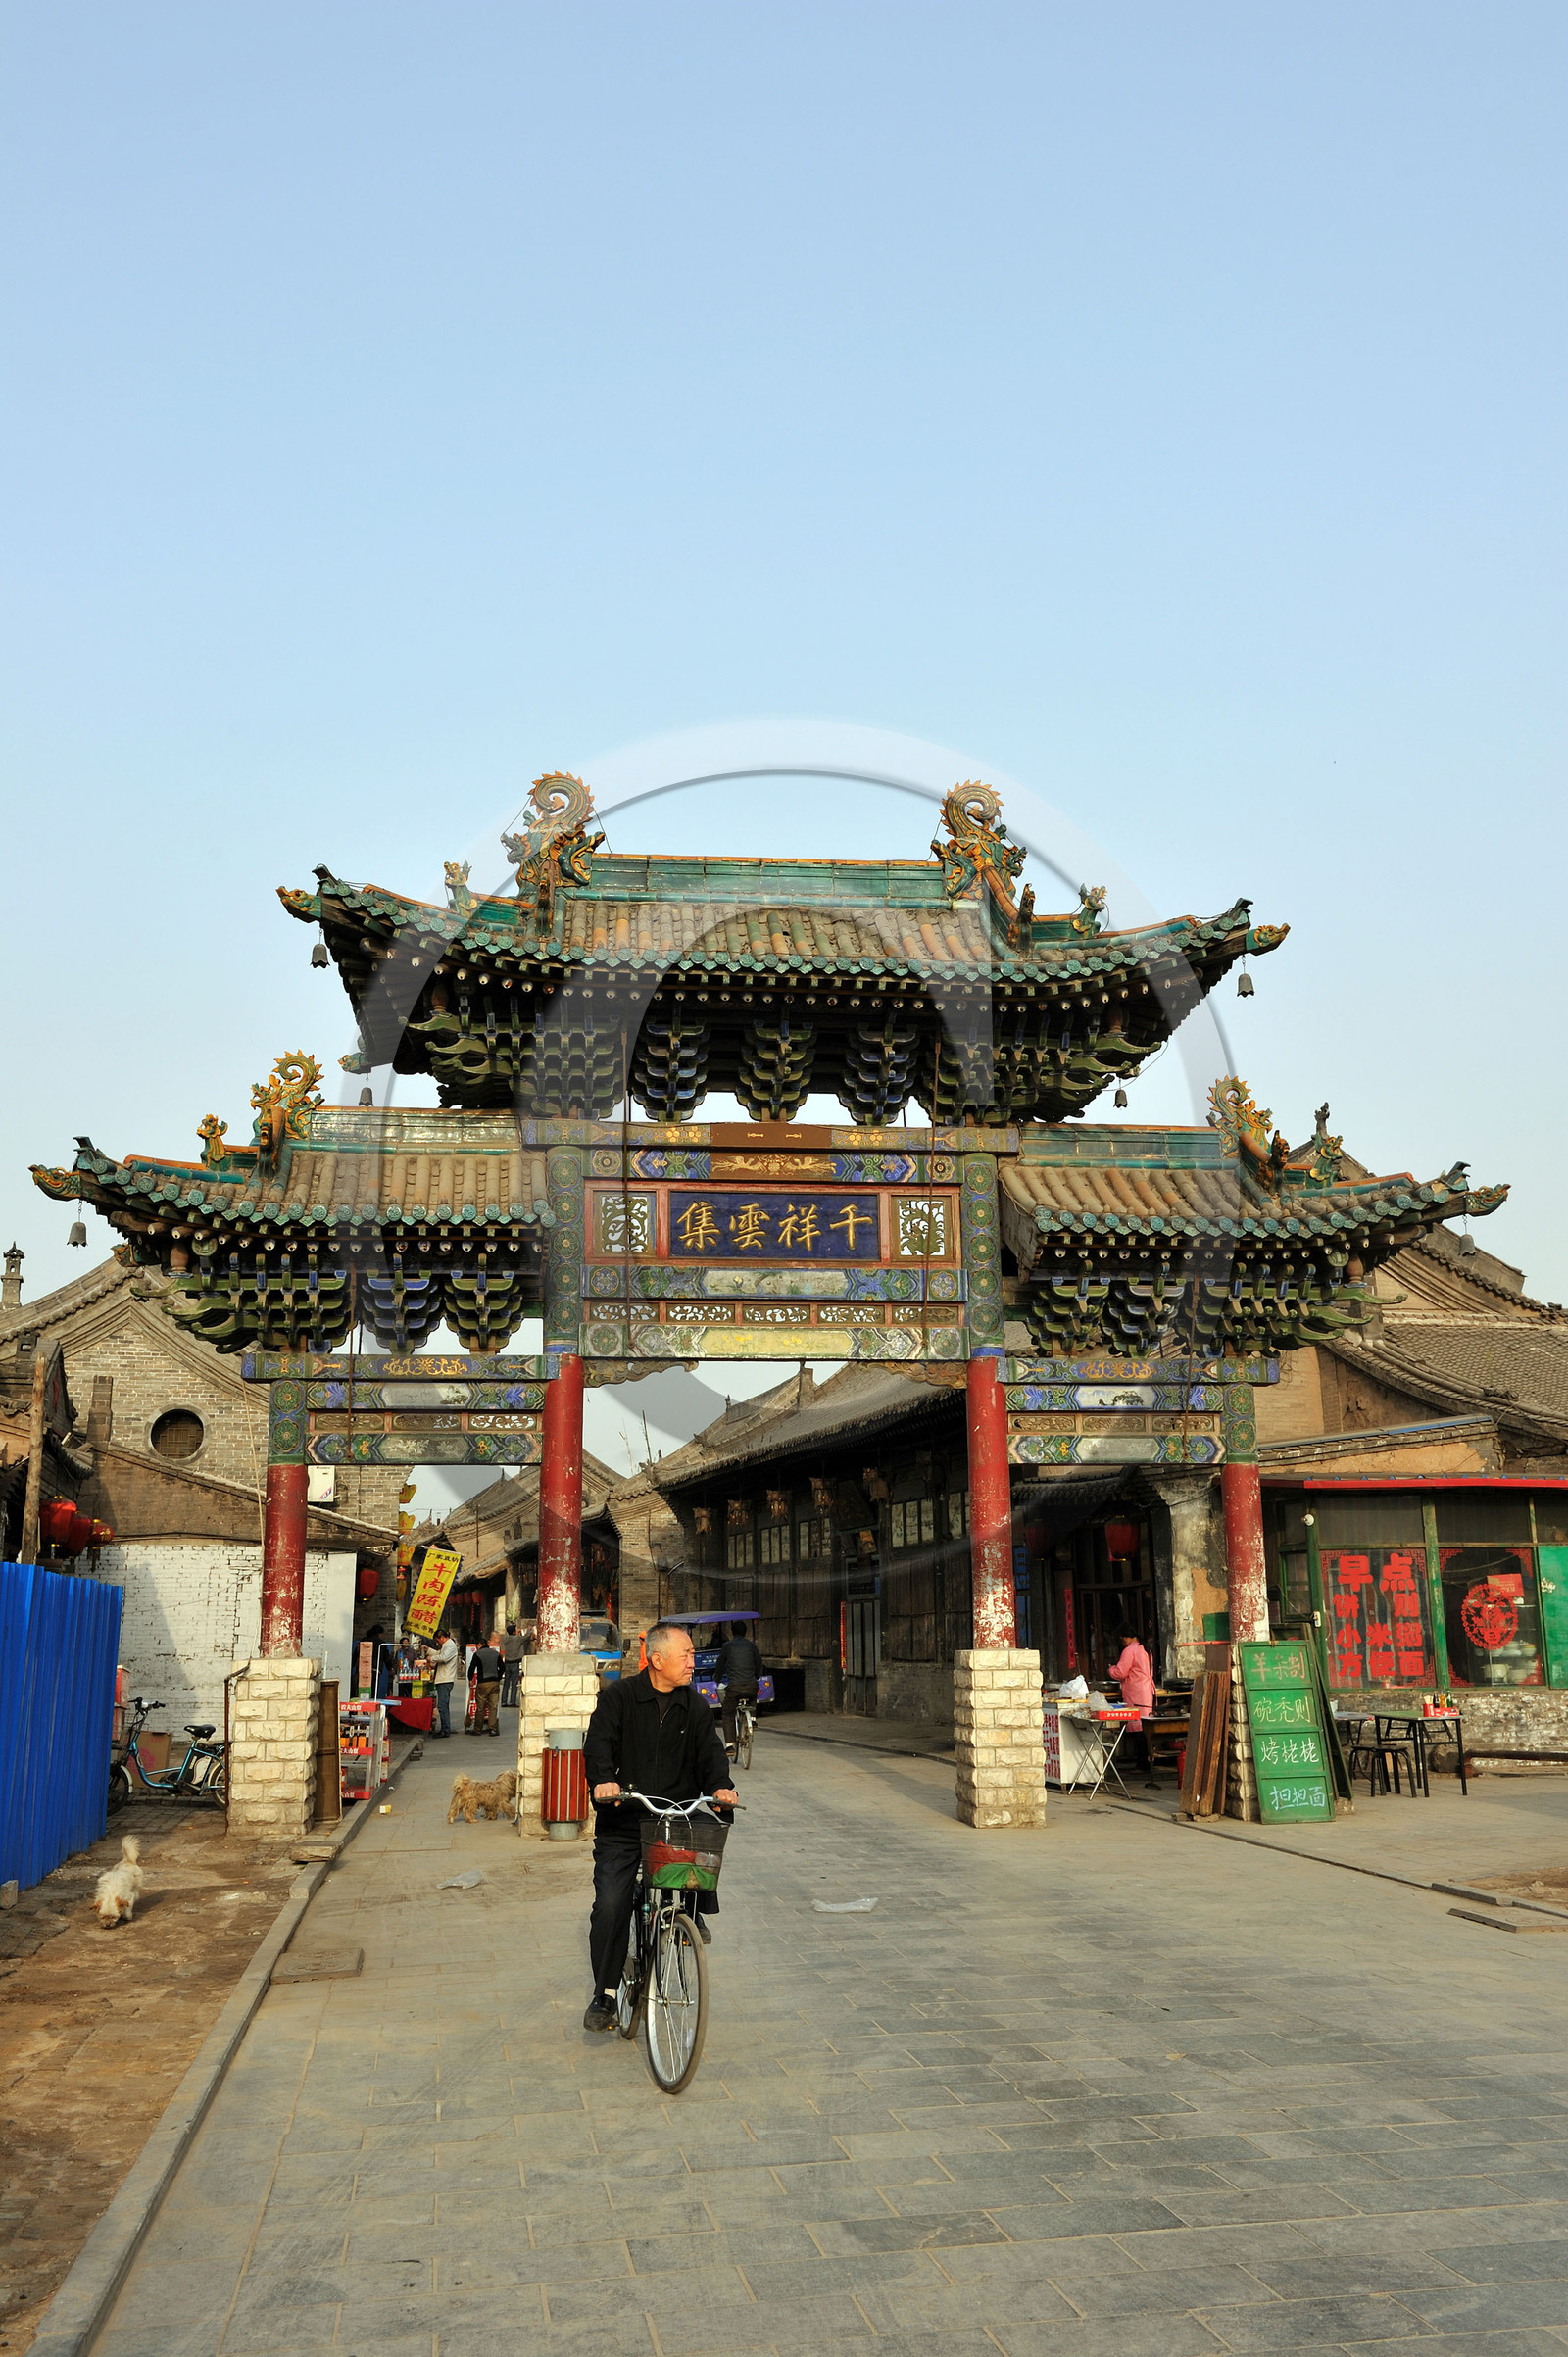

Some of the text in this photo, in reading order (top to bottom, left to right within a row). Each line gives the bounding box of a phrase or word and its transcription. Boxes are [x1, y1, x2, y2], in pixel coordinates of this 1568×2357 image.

[1337, 1552, 1416, 1592] 早点
[1336, 1622, 1423, 1648] 小米粥
[1338, 1651, 1424, 1677] 方便面
[1269, 1785, 1326, 1811] 担担面
